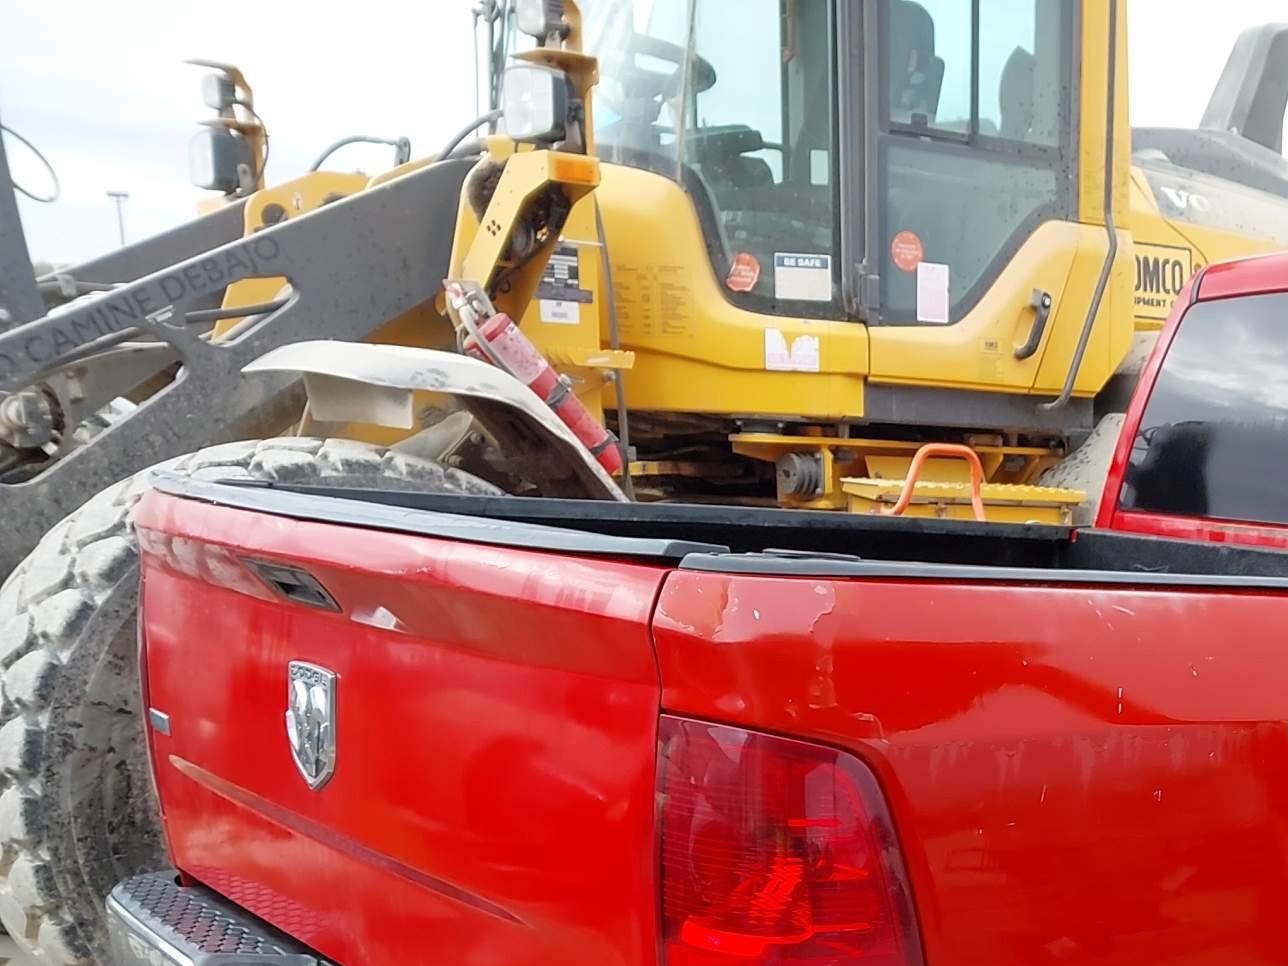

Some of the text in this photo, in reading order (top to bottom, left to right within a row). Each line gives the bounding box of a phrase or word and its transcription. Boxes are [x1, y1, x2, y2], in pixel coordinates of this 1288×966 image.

[798, 257, 821, 268] SAFE
[24, 288, 152, 363] CAMINE
[159, 235, 280, 303] DEBAJO
